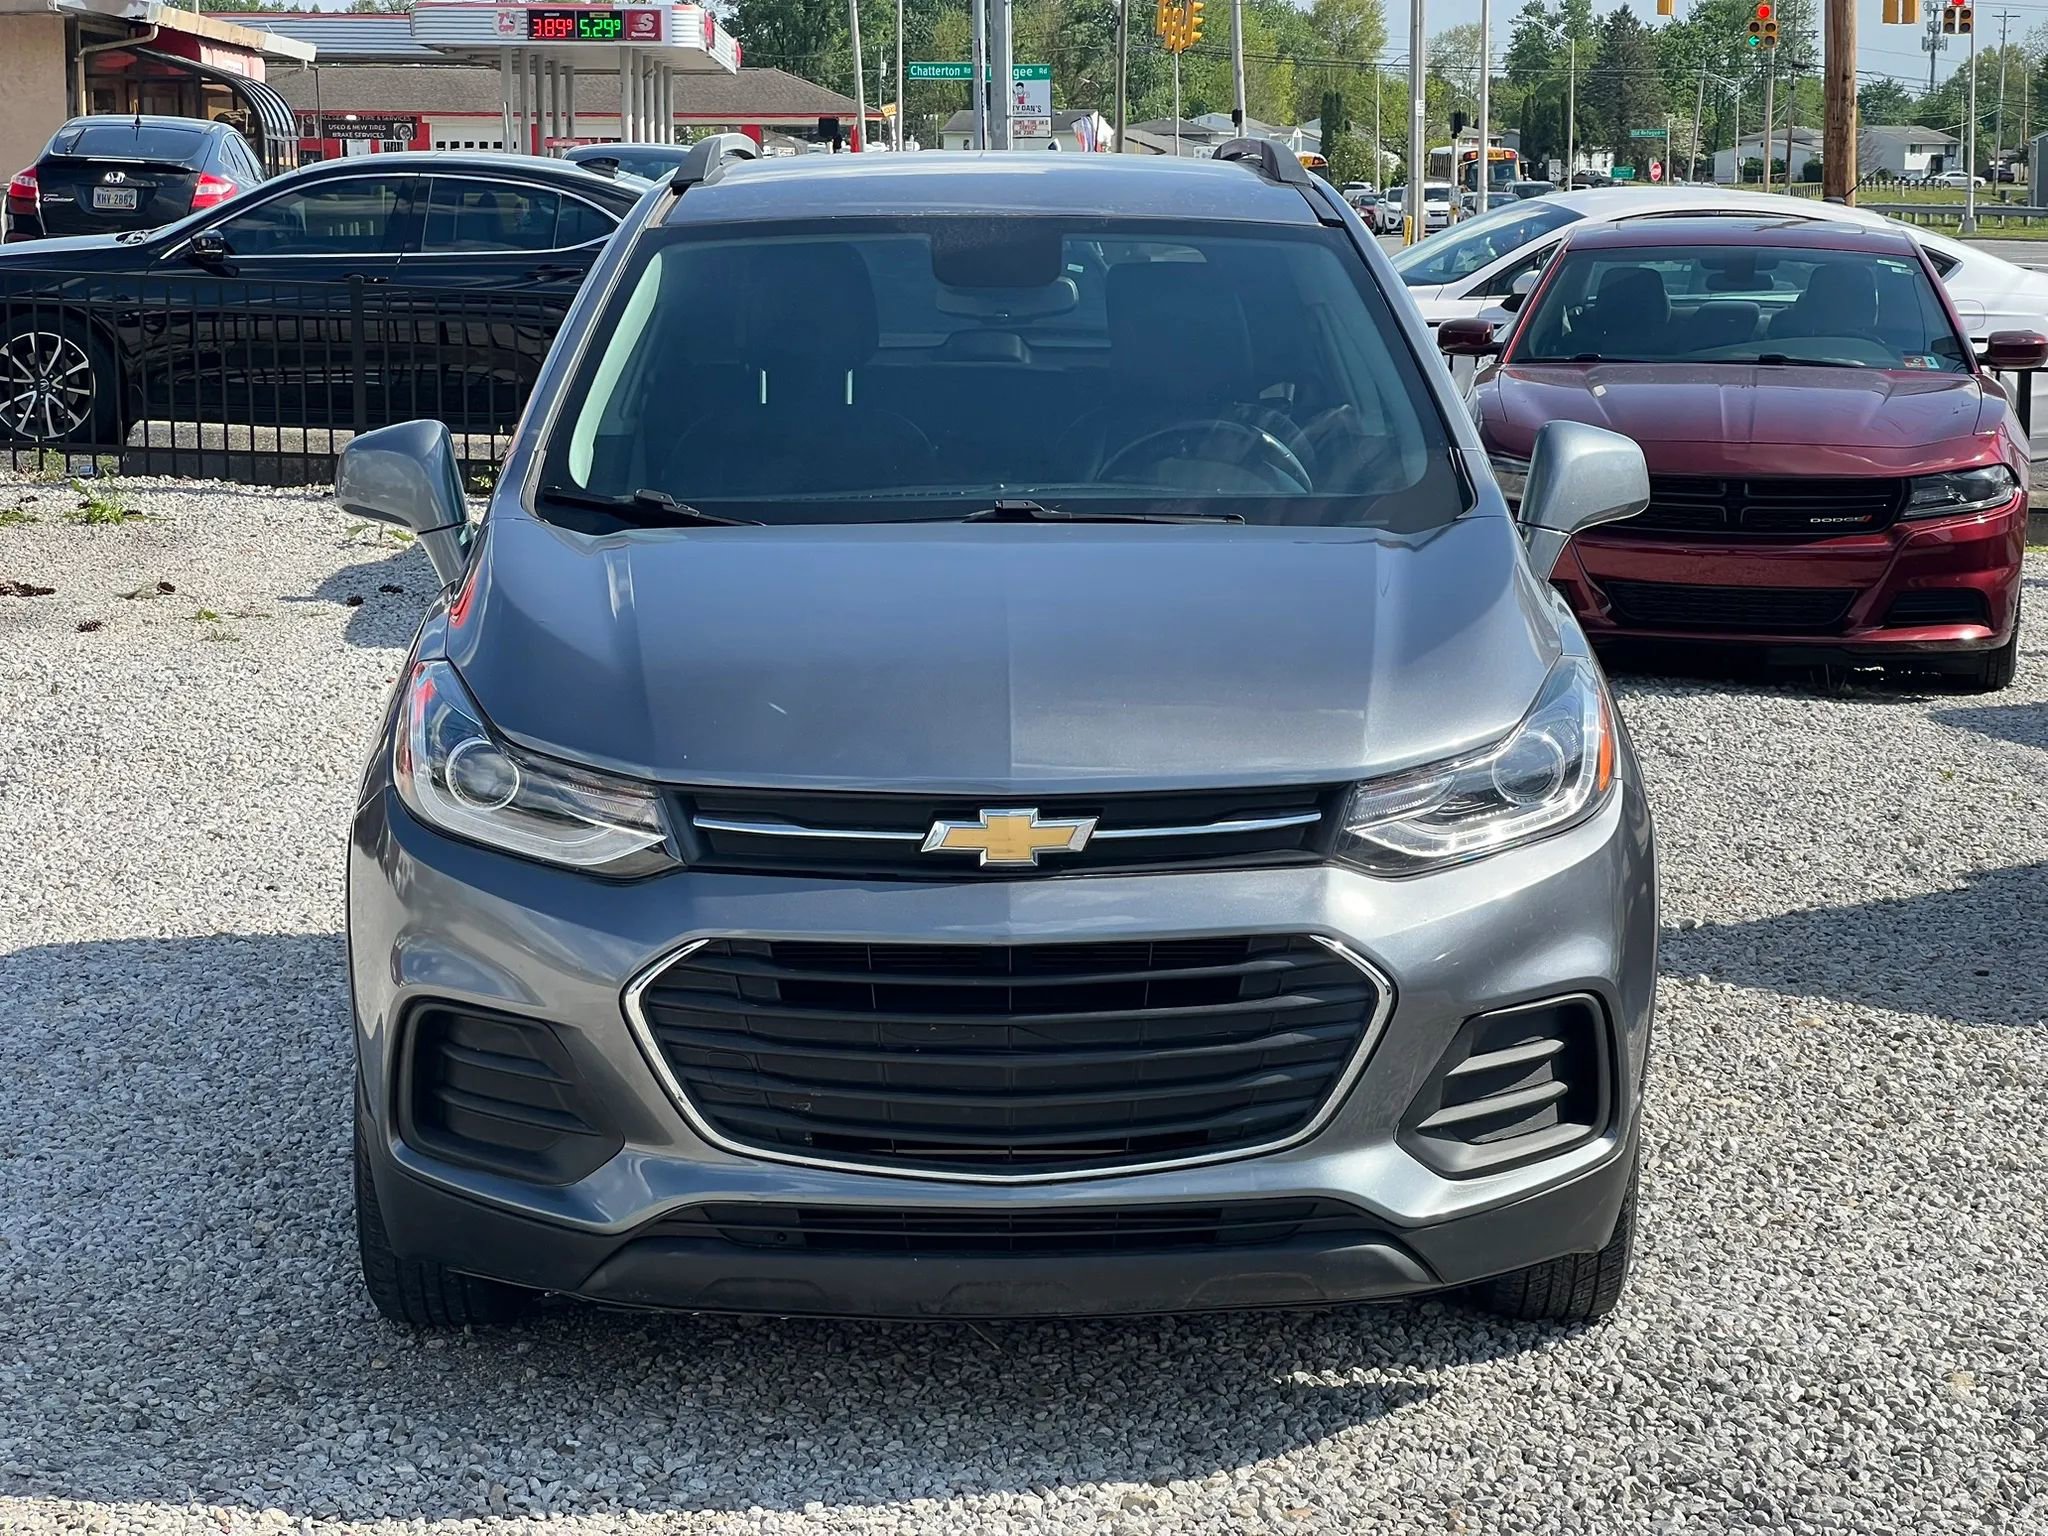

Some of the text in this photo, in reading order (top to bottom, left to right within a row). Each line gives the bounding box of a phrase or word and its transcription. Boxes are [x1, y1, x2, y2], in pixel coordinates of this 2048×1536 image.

[910, 65, 971, 77] Chatterton Rd
[1039, 67, 1048, 75] Rd
